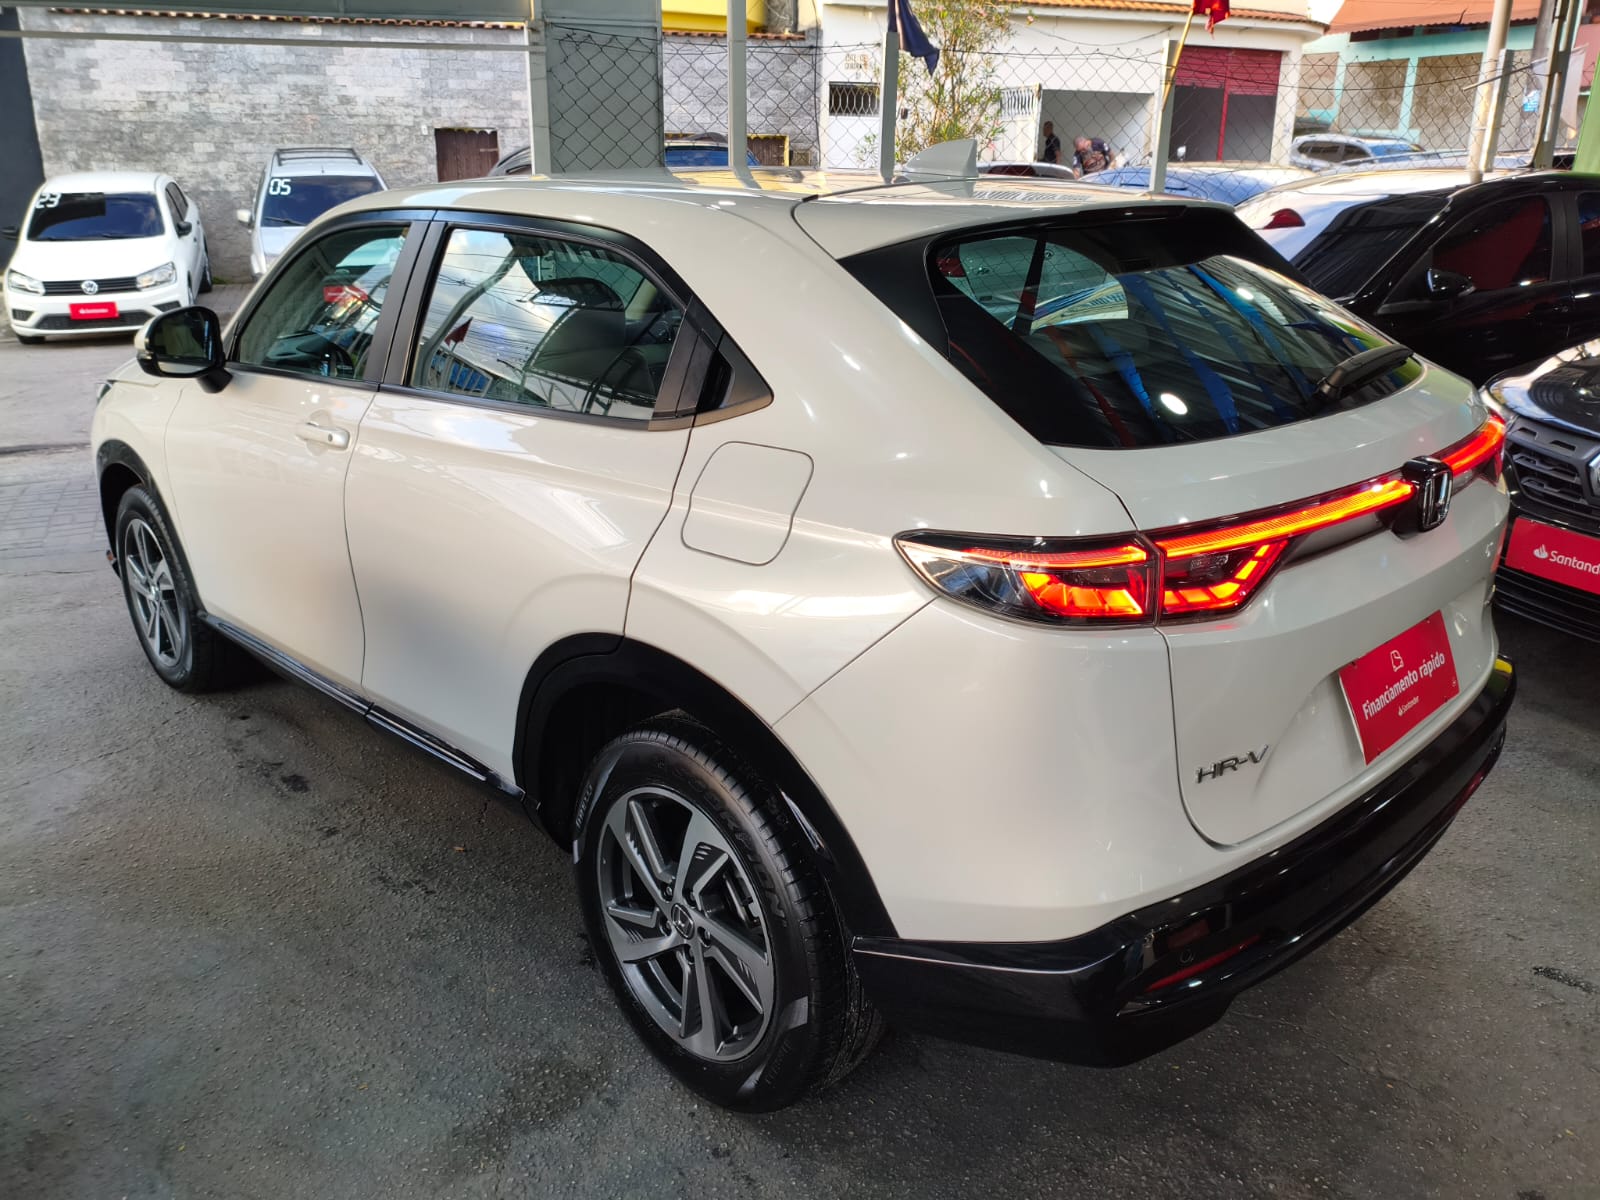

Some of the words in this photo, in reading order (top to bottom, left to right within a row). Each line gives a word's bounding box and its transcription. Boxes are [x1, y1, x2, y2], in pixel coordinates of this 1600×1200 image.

[35, 192, 61, 209] 23
[269, 178, 292, 195] 05
[1362, 669, 1418, 720] Financiamento
[1419, 651, 1445, 679] rápido
[1197, 745, 1268, 784] HR-V
